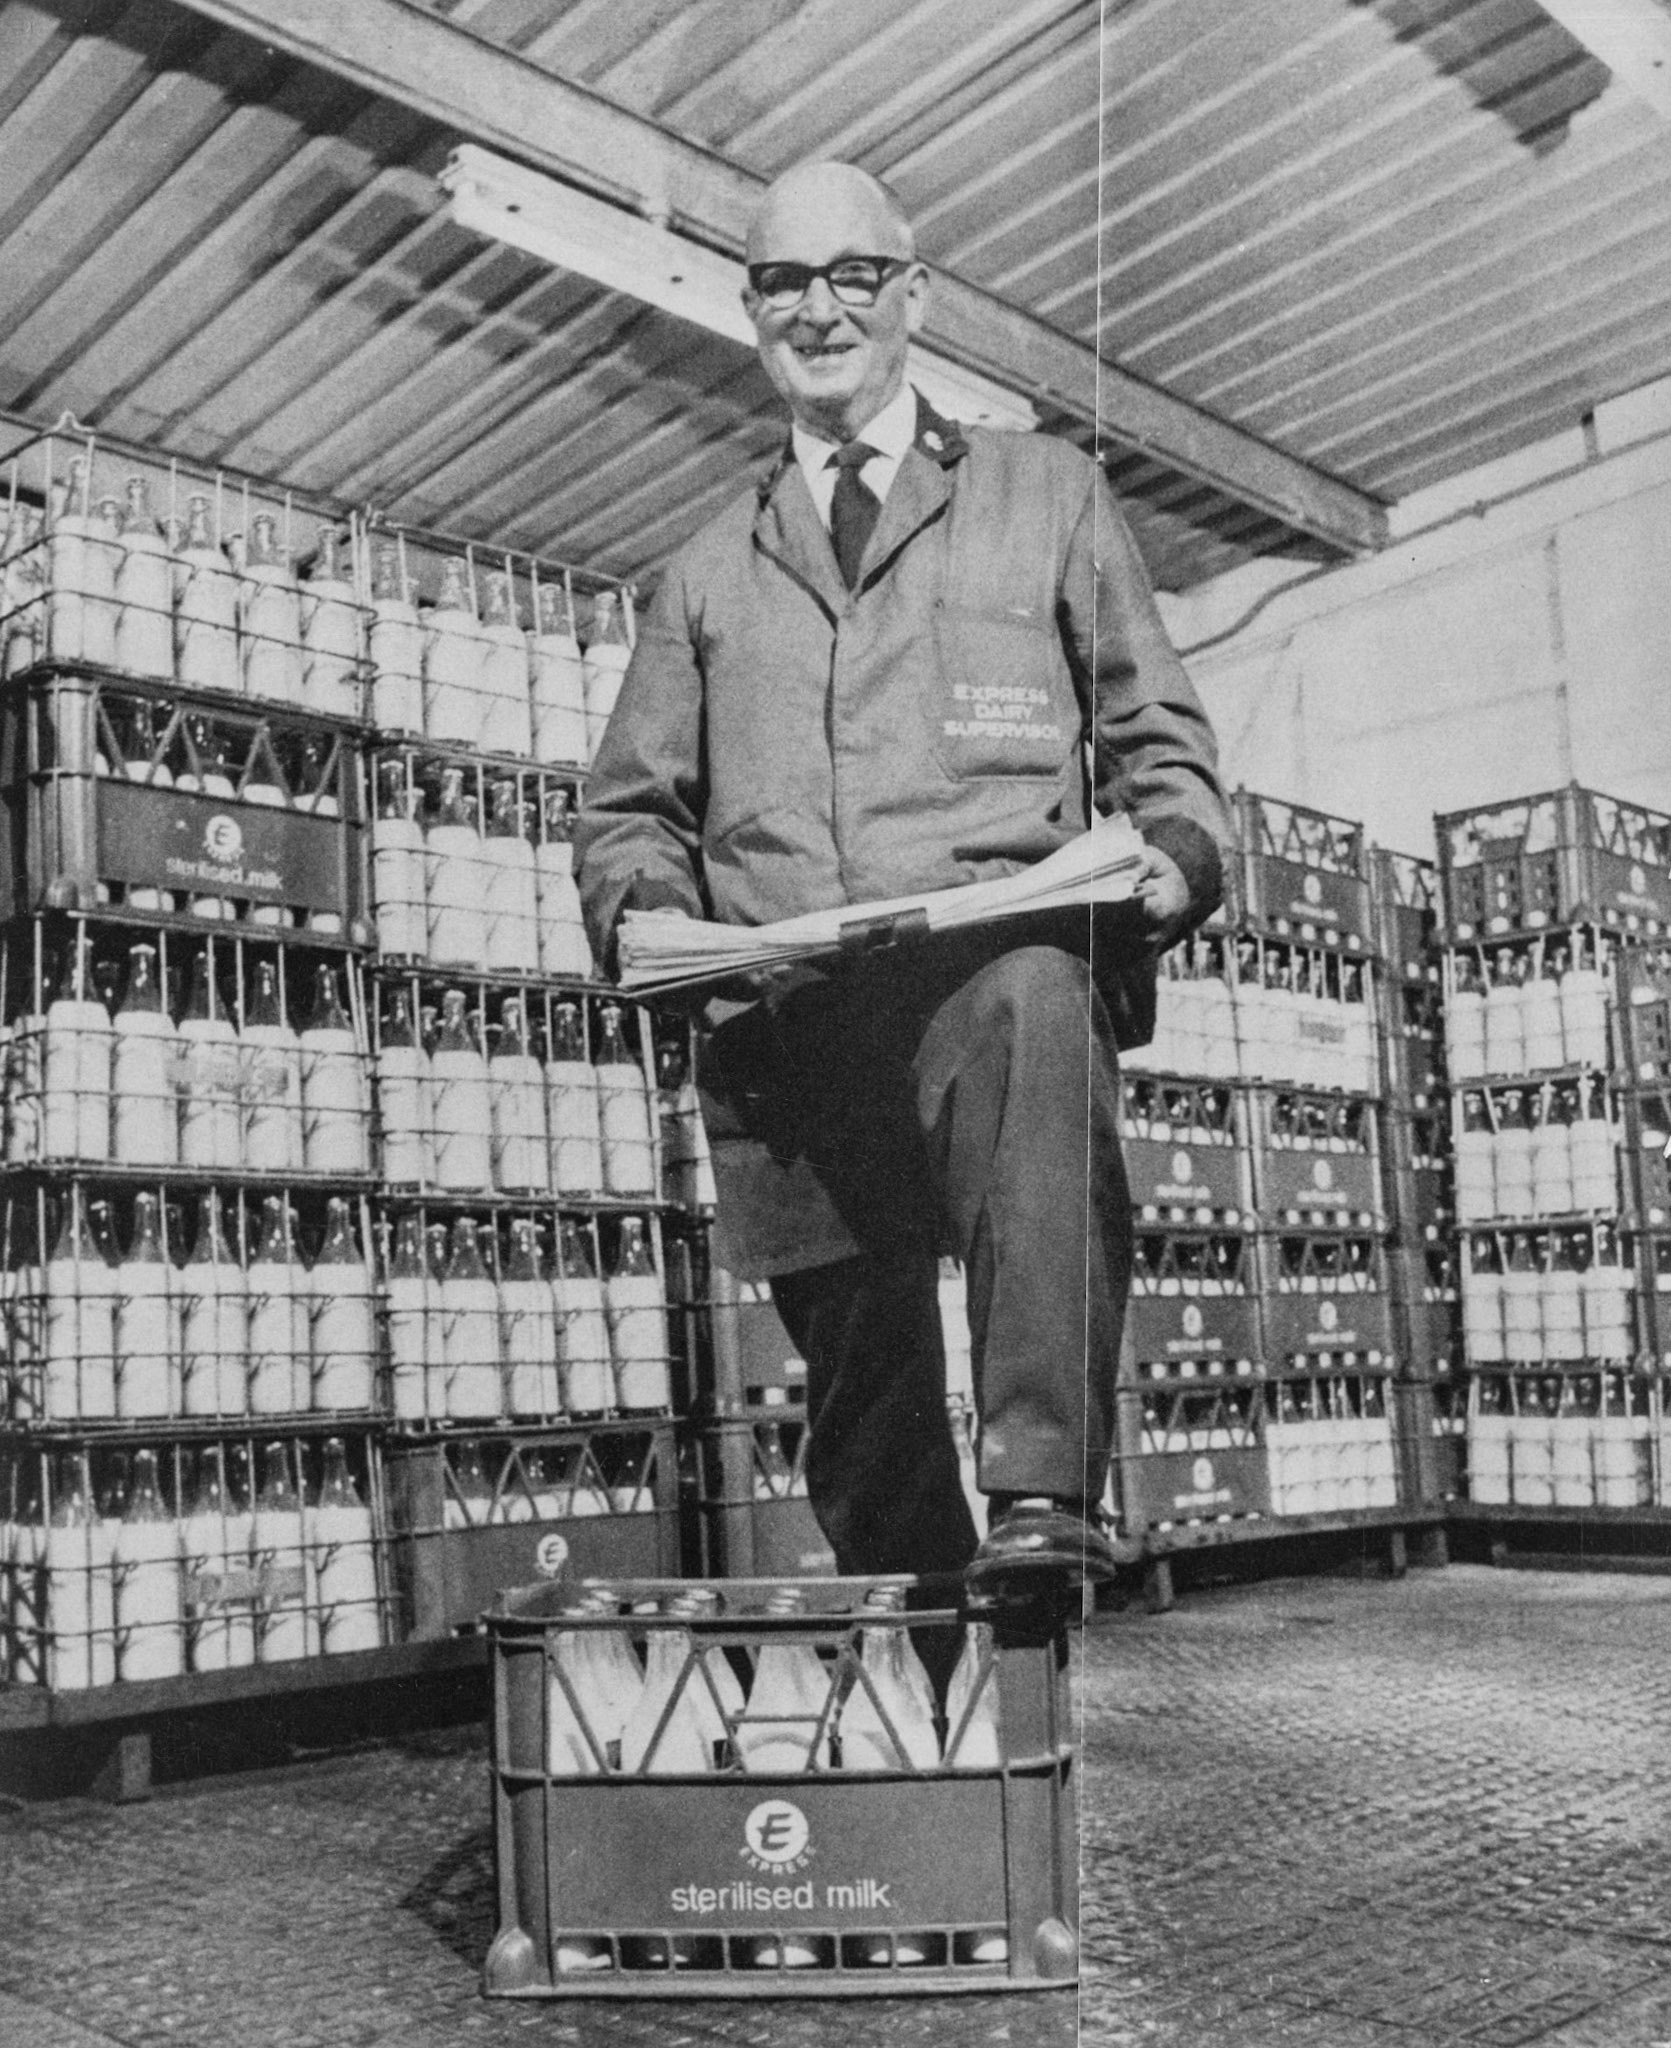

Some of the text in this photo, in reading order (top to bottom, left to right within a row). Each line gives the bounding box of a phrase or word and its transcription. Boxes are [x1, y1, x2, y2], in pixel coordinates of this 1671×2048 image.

[953, 684, 1049, 705] EXPRESS
[975, 703, 1033, 720] DAIRY
[944, 720, 1061, 740] SUPERVISOR
[757, 1812, 792, 1851] E
[671, 1879, 891, 1912] sterilised milk
